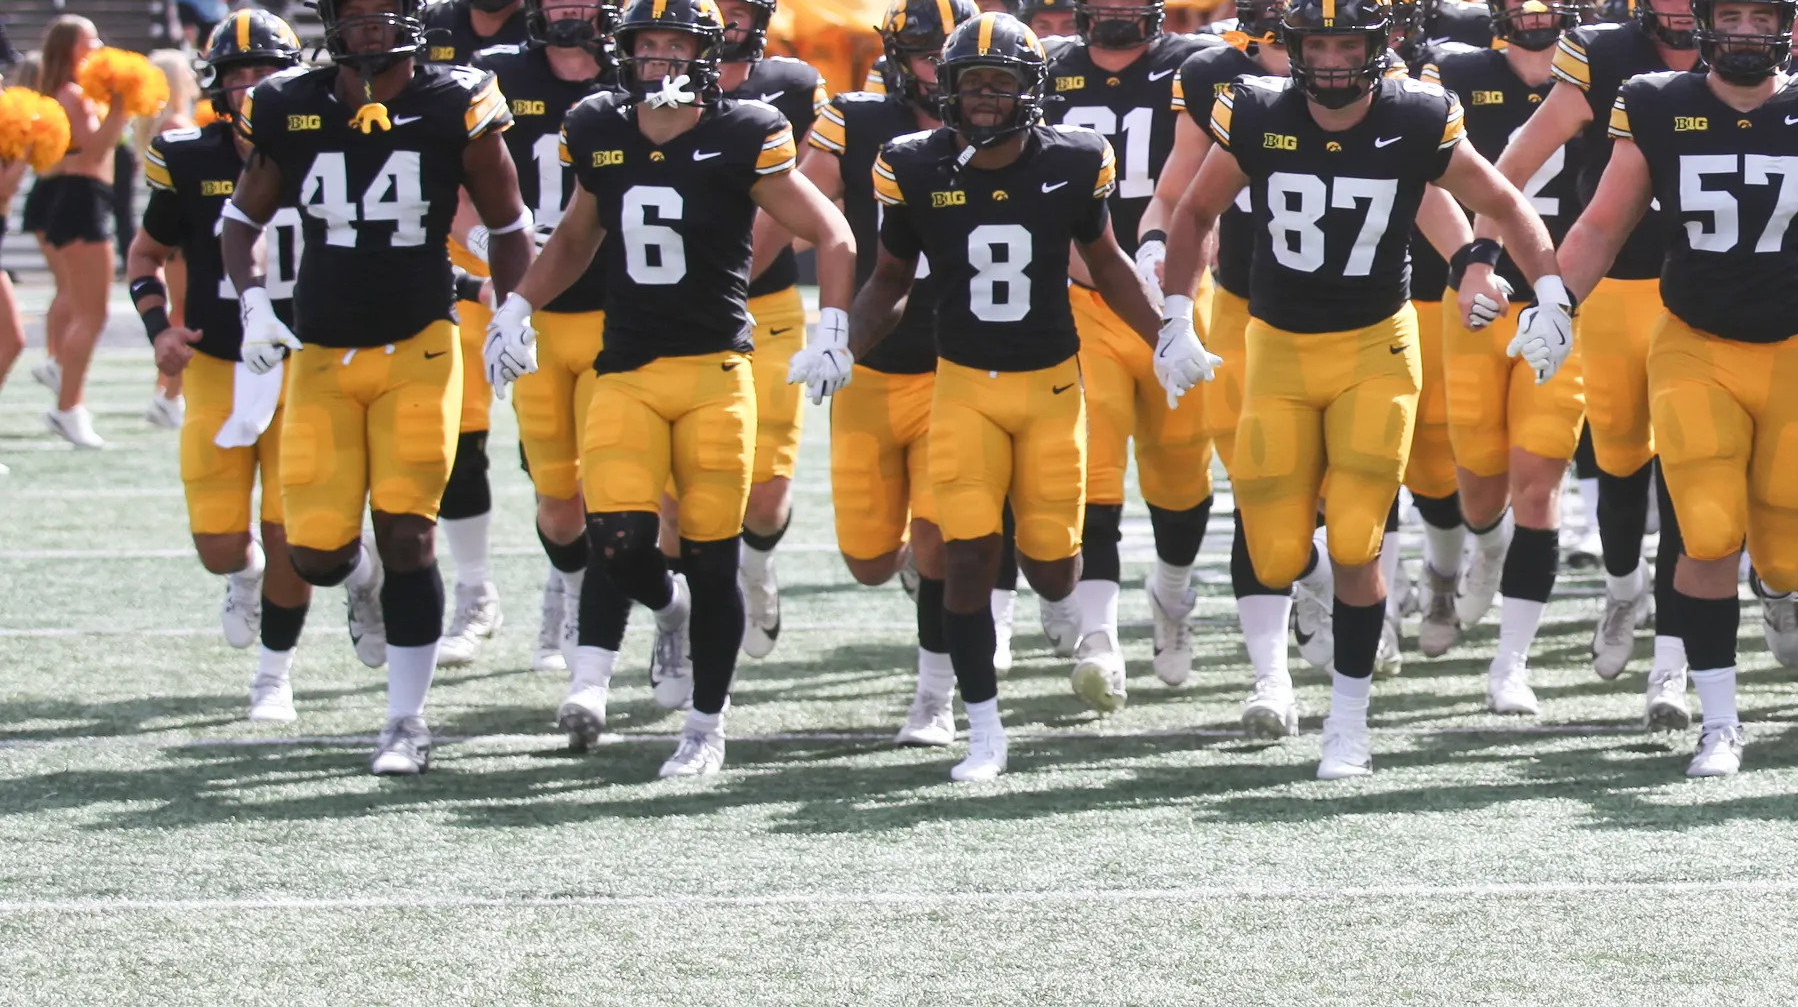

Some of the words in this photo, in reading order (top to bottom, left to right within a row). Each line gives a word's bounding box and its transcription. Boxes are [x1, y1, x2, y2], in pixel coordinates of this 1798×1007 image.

[302, 151, 430, 248] 44
[1063, 105, 1156, 199] 1
[622, 185, 687, 285] 6
[968, 224, 1033, 323] 8
[1267, 172, 1399, 277] 87
